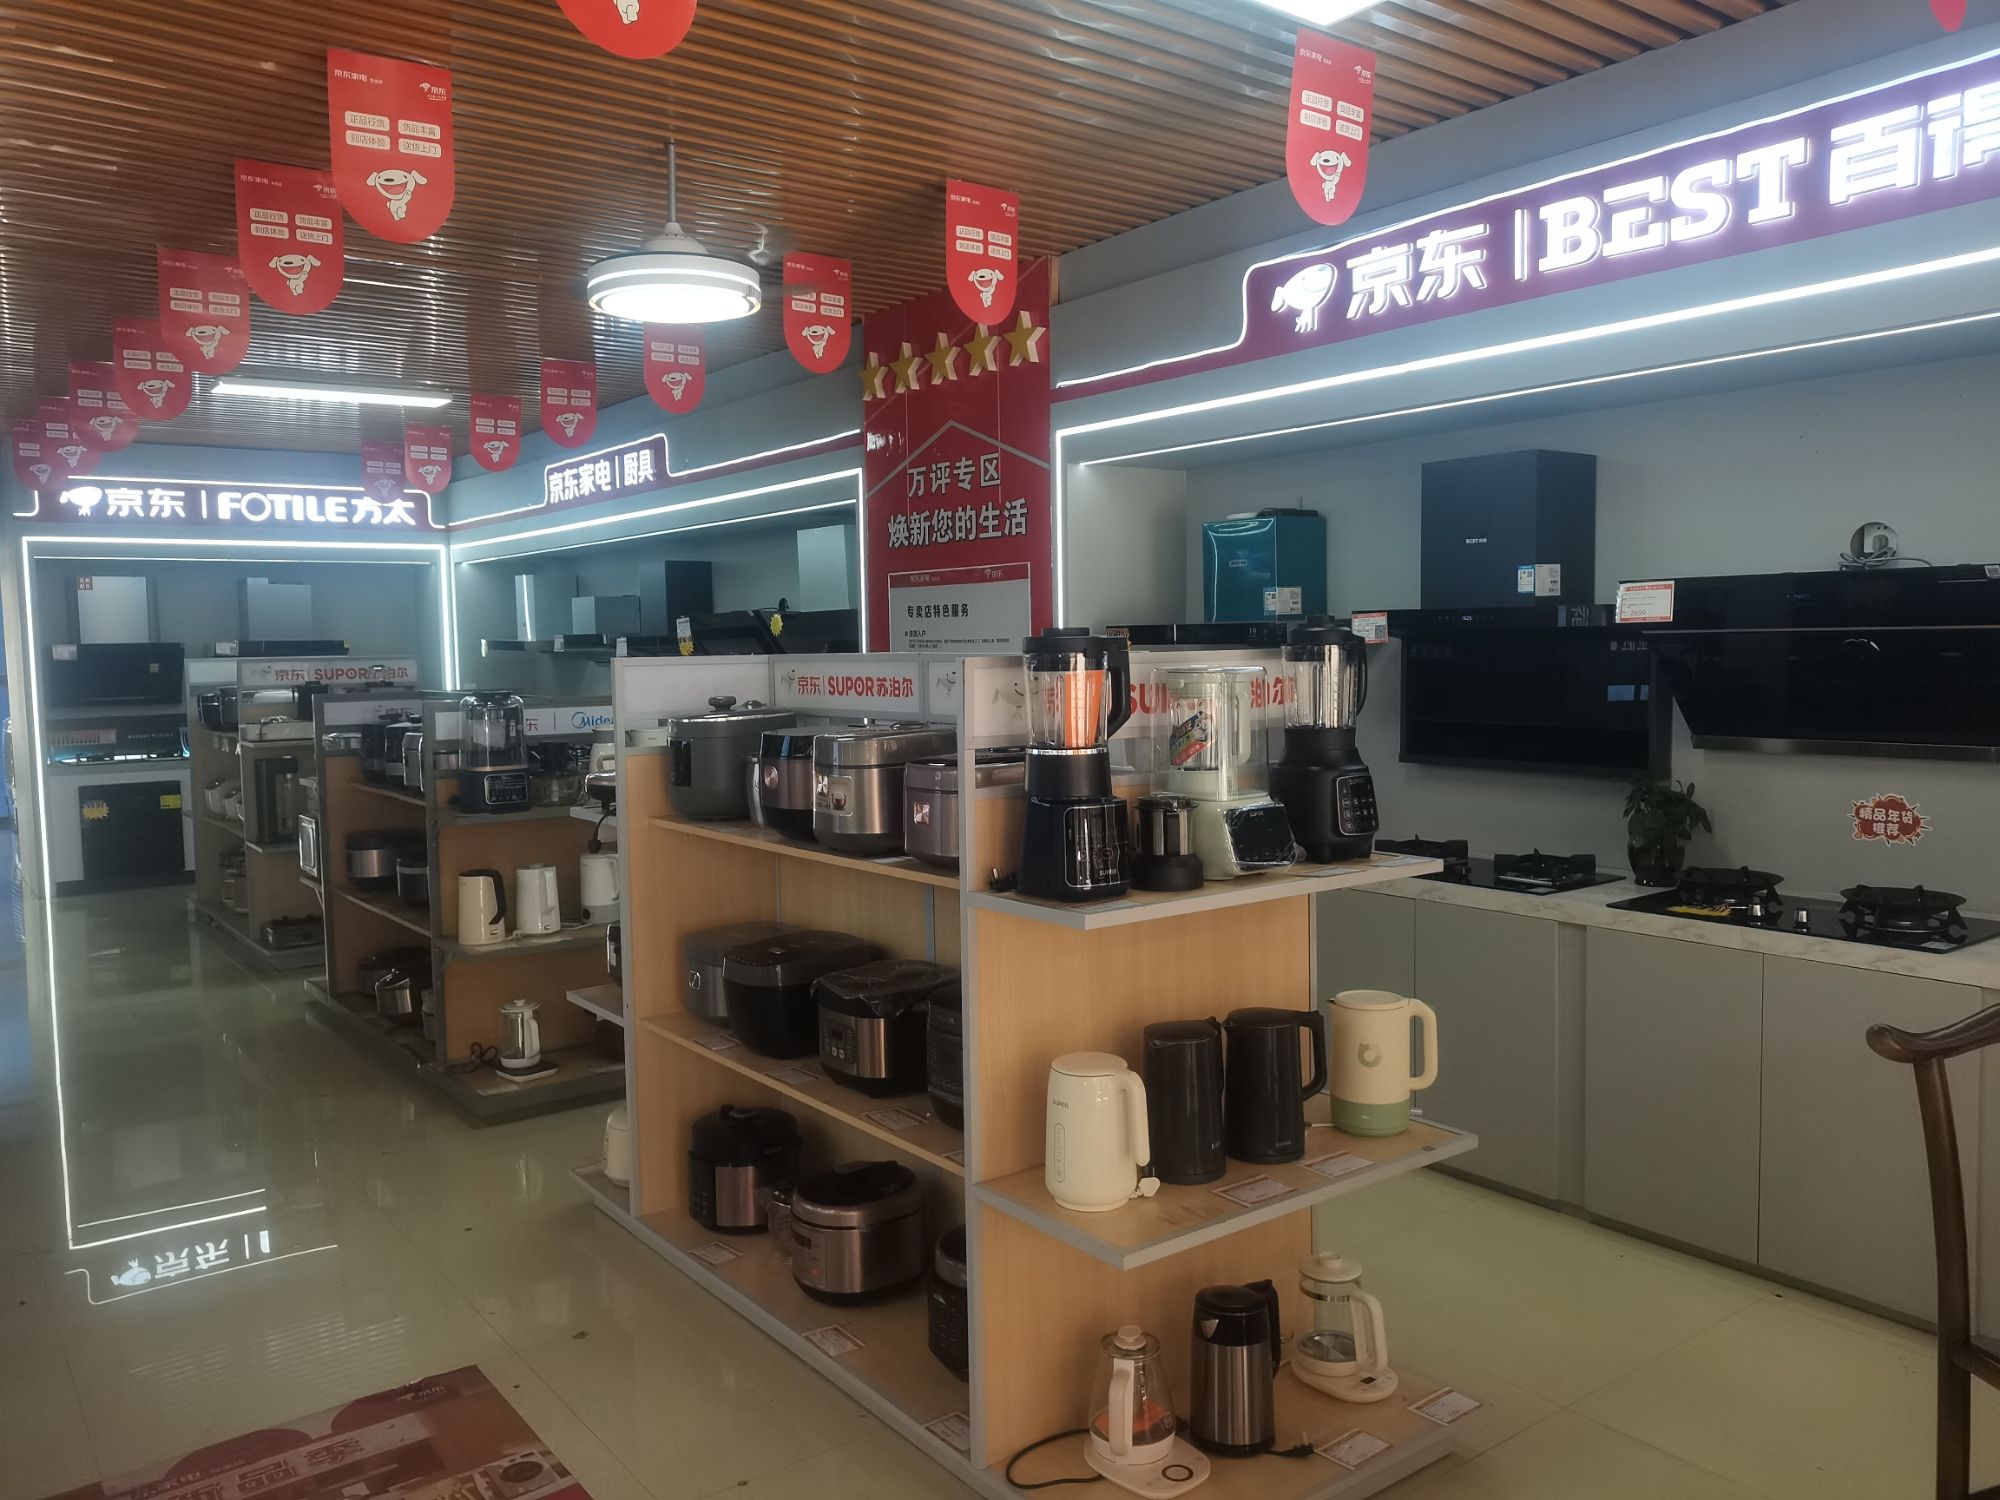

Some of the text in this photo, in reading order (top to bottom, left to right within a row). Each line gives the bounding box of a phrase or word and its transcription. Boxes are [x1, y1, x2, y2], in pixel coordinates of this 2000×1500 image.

[350, 114, 385, 128] 正品行货
[402, 122, 436, 137] 货品丰富
[350, 133, 386, 147] 到店体验
[403, 141, 437, 155] 送货上门
[1346, 223, 1490, 320] 京东
[1537, 136, 1811, 274] BEST
[548, 448, 654, 504] 京东家电 厨具
[907, 452, 1001, 499] 万评专区
[105, 487, 416, 526] 京东 FOTILE 方太
[887, 497, 1028, 549] 焕新您的生活
[907, 603, 969, 619] 专卖店特色服务
[274, 669, 305, 682] 京东
[313, 667, 368, 681] SUPOR
[797, 675, 914, 698] 京东 SUPOR 苏泊尔
[1859, 807, 1914, 825] 精品年货
[1872, 822, 1900, 836] 推荐
